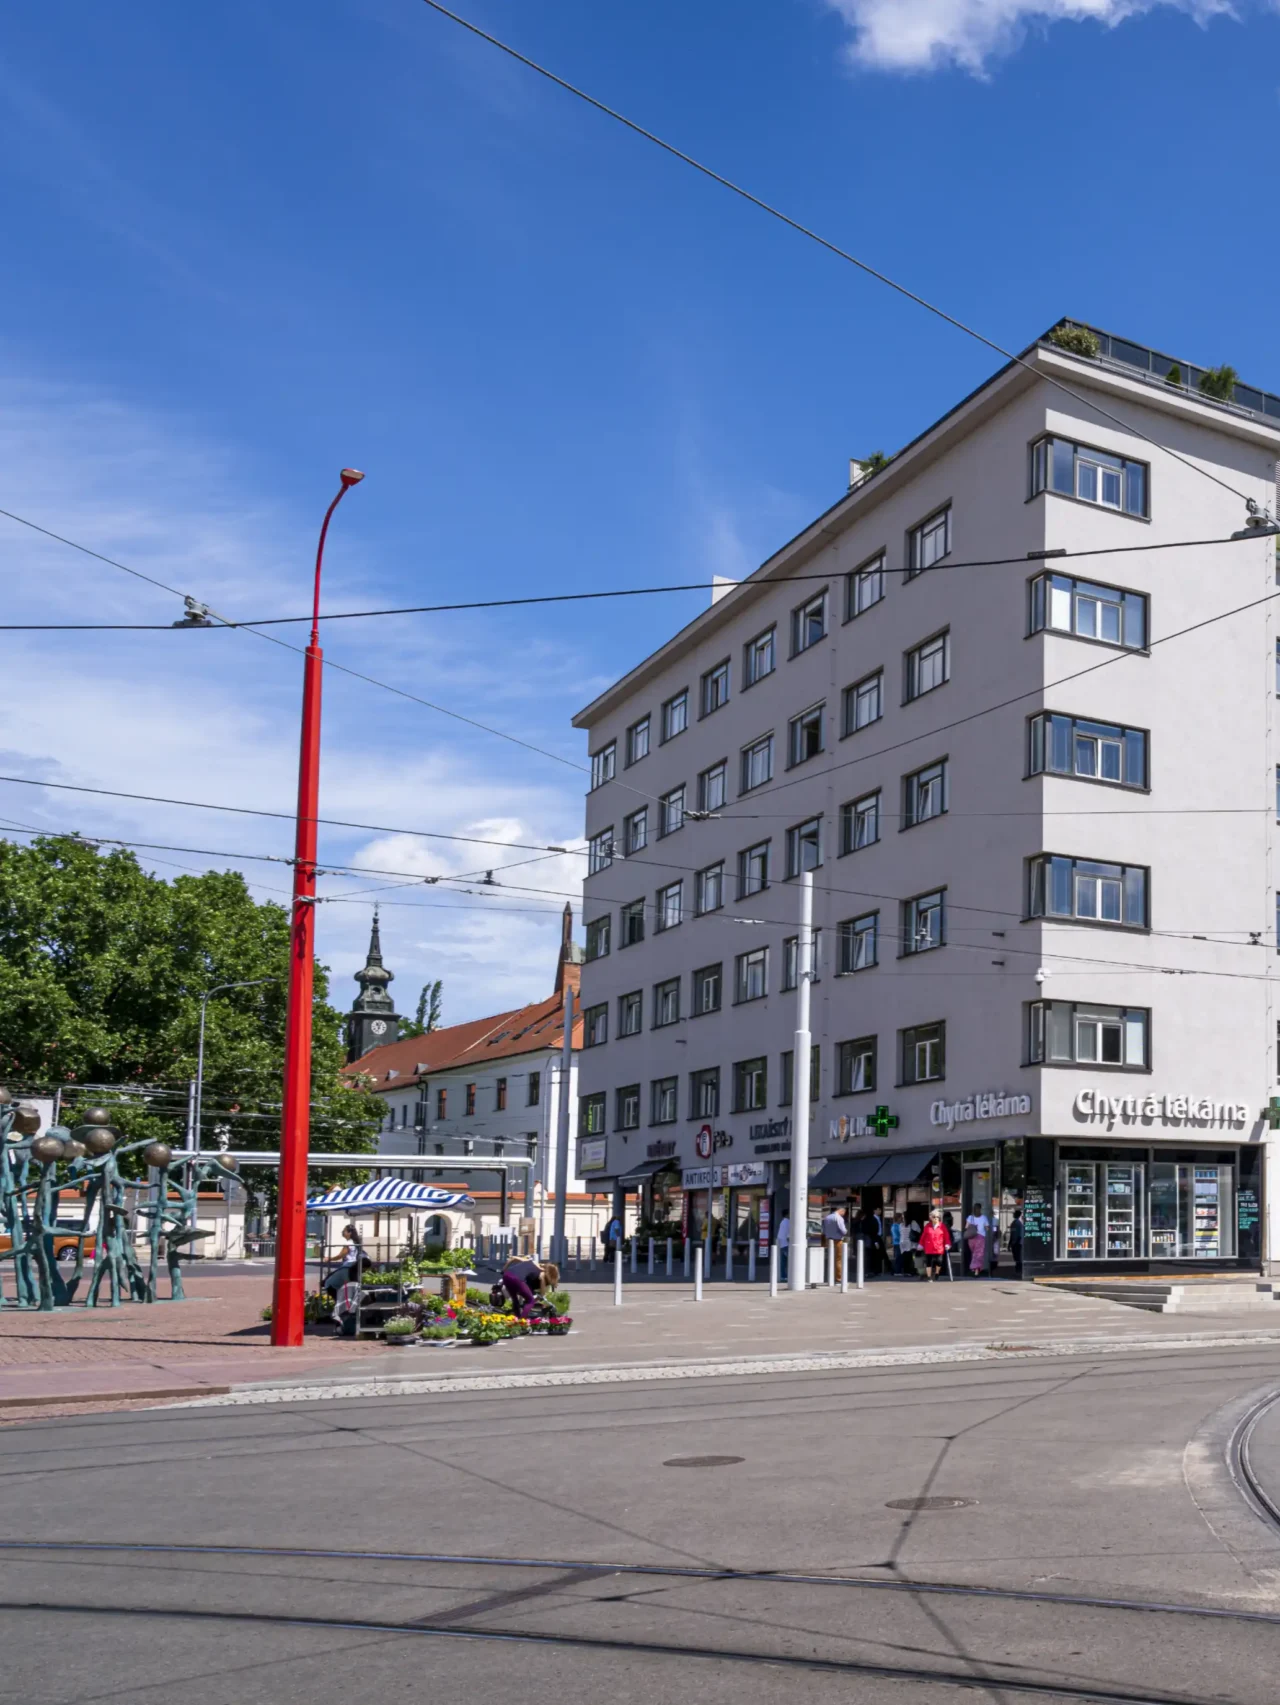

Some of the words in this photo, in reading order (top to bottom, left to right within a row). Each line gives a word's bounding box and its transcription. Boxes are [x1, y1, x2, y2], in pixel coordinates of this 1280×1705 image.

[930, 1096, 974, 1130] Chytrá
[975, 1092, 1031, 1119] lékárna
[1076, 1089, 1157, 1123] Chytrá
[1164, 1093, 1250, 1121] lékárna
[685, 1170, 718, 1185] ANTIKFOO
